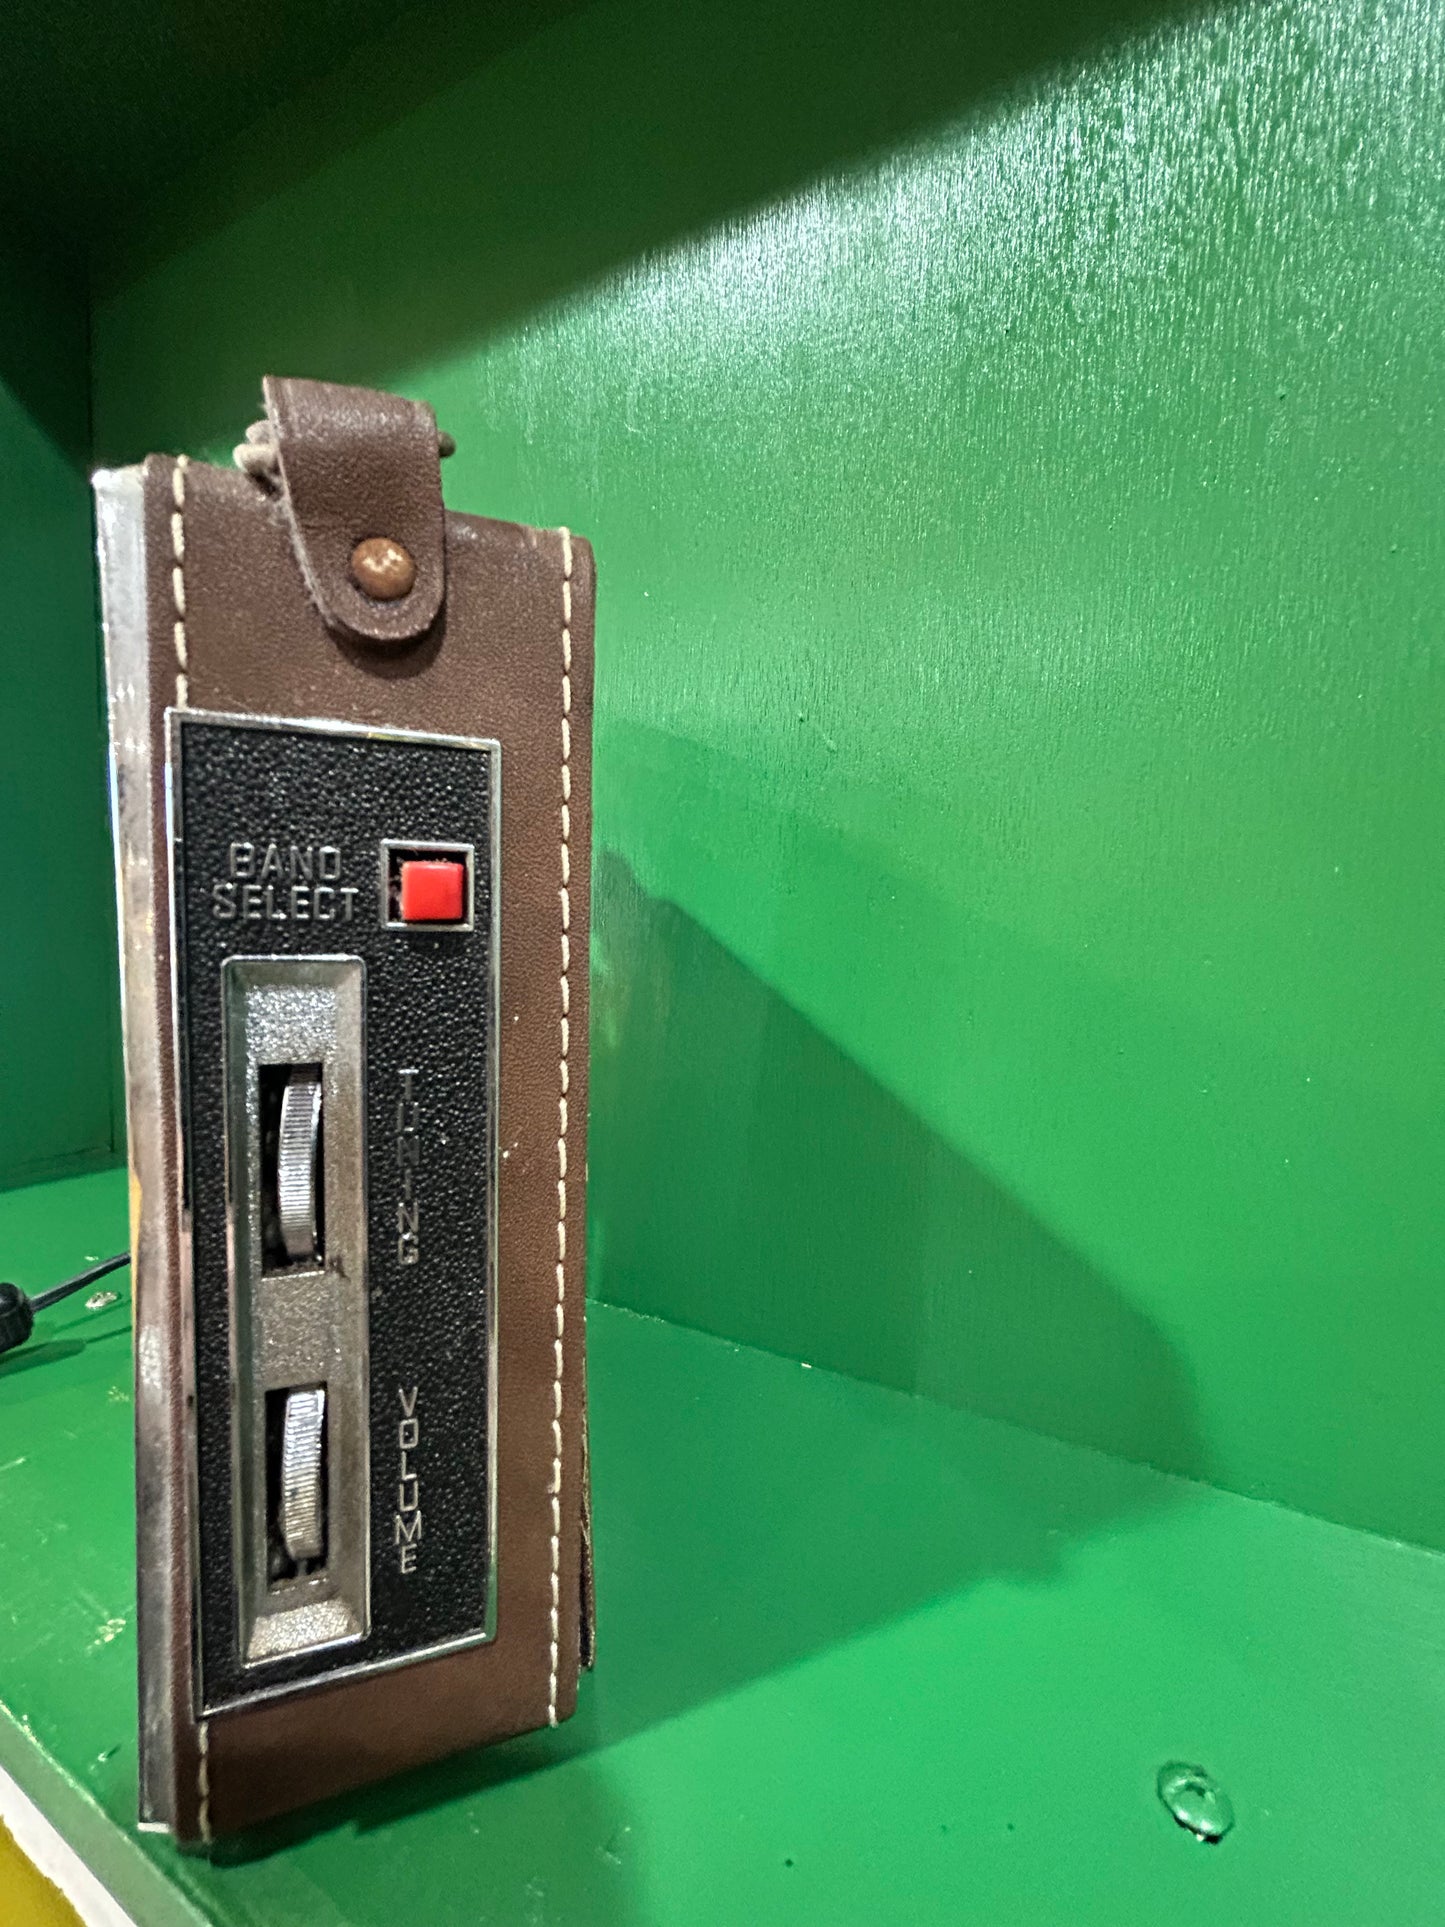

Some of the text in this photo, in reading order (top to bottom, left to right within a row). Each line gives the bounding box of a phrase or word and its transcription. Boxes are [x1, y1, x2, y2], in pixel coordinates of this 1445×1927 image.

[212, 882, 359, 920] SELECT
[230, 842, 341, 880] BAND
[397, 1068, 420, 1265] TUNING
[395, 1386, 422, 1574] VOLUME
